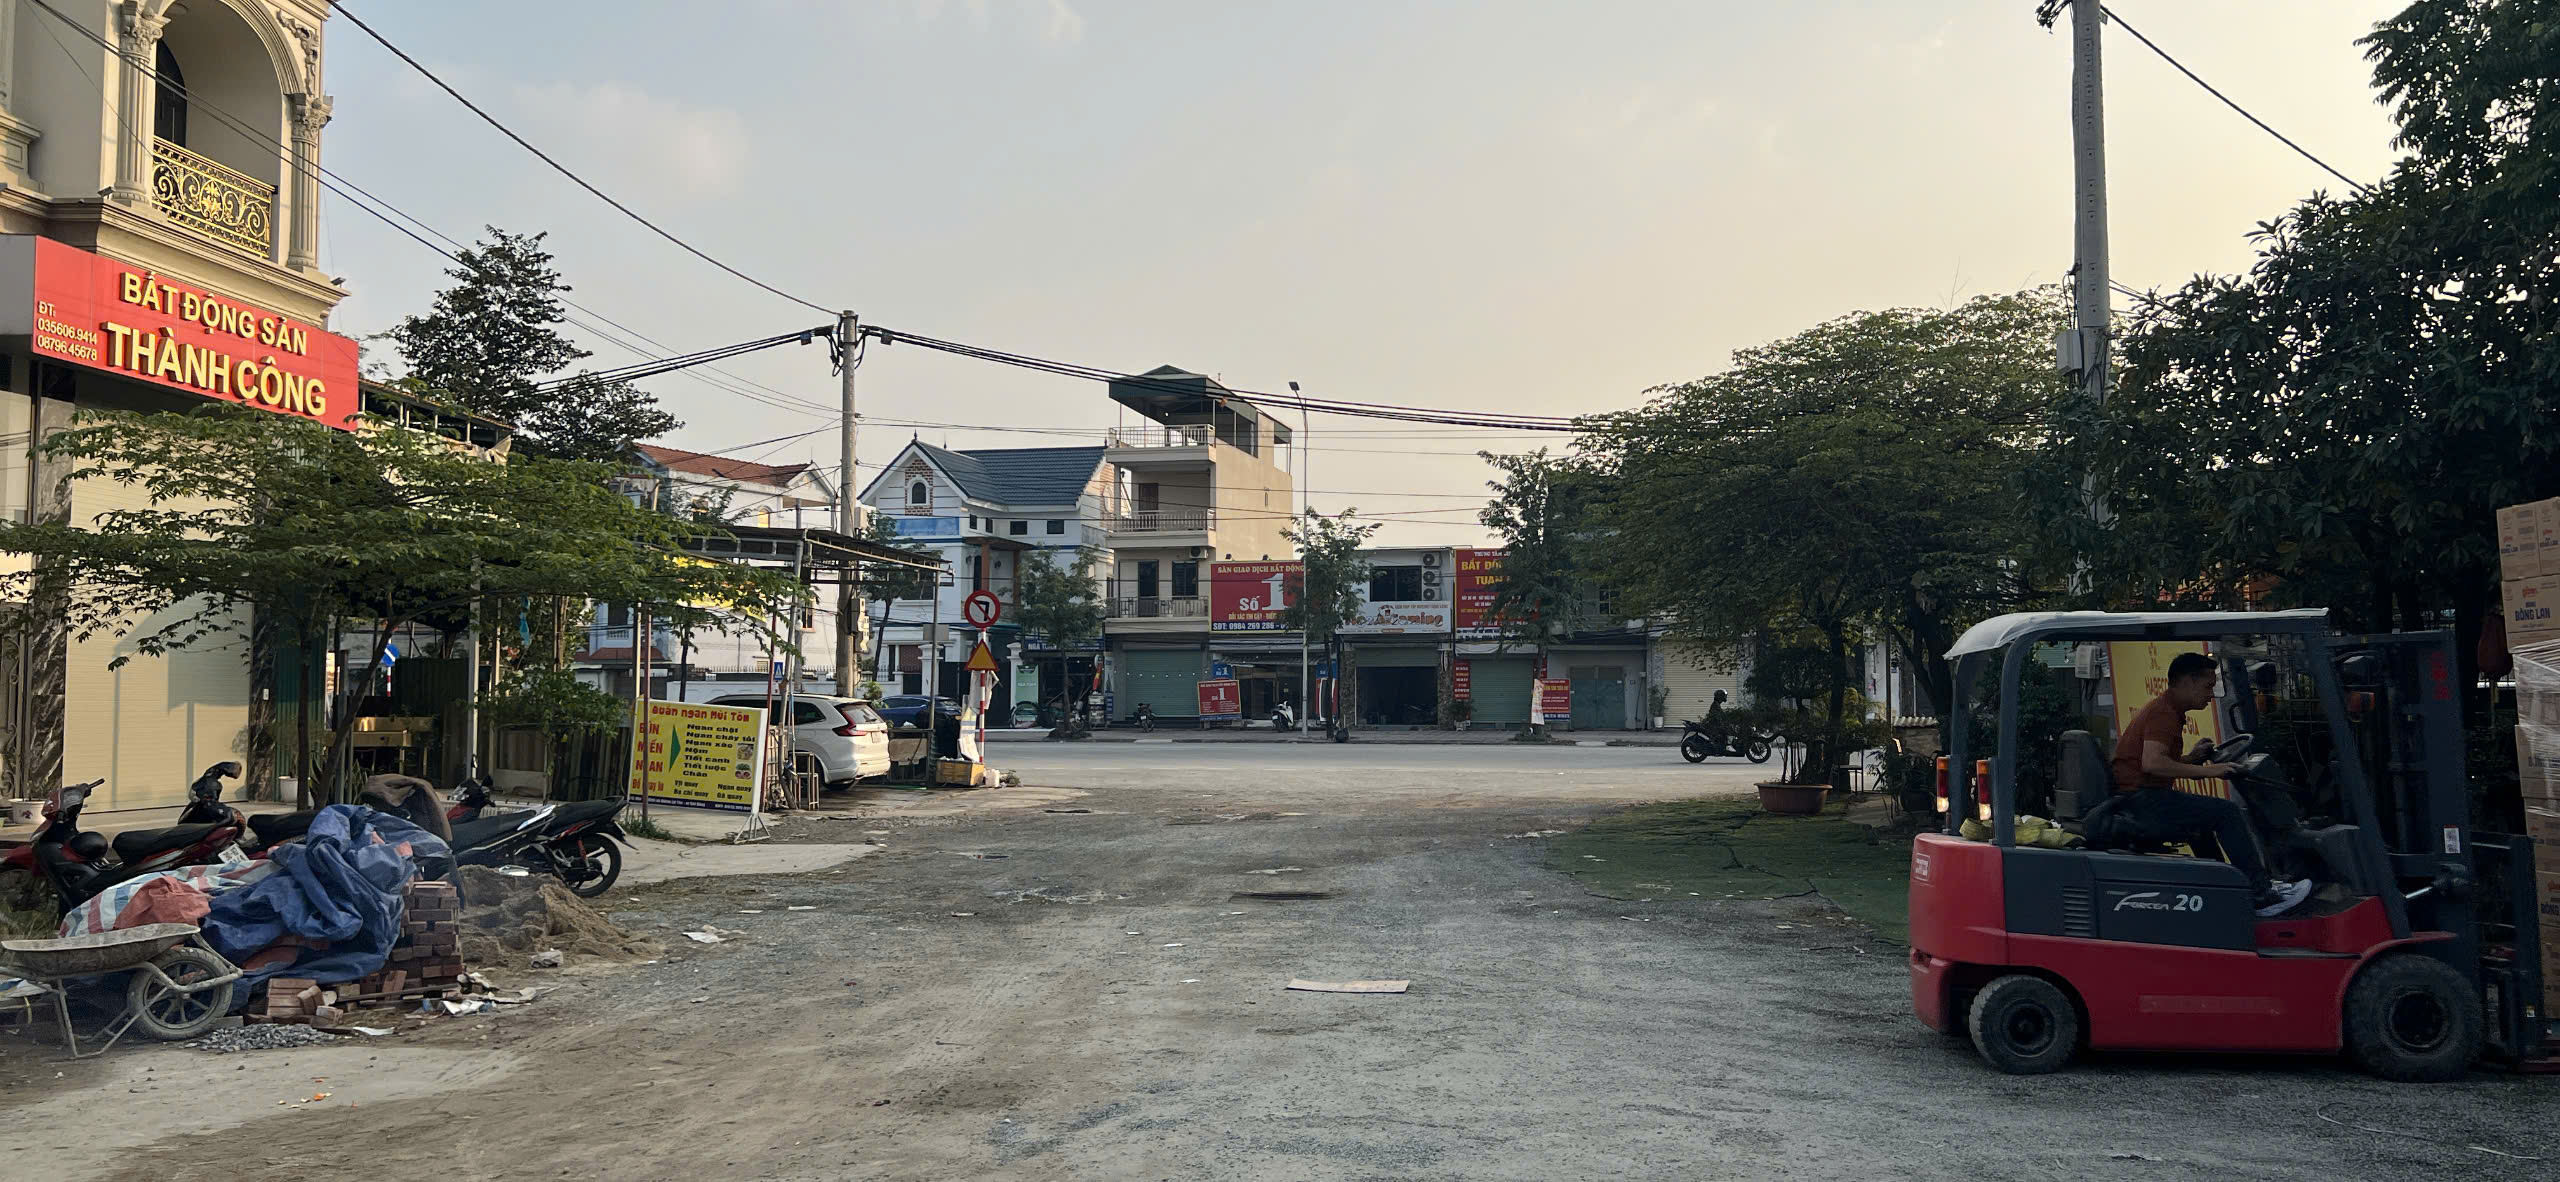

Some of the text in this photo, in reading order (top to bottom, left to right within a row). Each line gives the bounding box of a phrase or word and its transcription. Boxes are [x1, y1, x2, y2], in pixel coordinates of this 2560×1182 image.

[120, 271, 307, 356] BẤT ĐỘNG SẢN
[37, 317, 98, 345] 035606.9414
[37, 335, 98, 361] 08796.45678
[101, 321, 326, 416] THÀNH CÔNG
[1217, 565, 1232, 573] SÀN
[1252, 565, 1269, 574] DỊCH
[1240, 573, 1291, 611] Số 1
[681, 709, 707, 719] ngan
[635, 760, 663, 772] NAN
[2173, 894, 2203, 912] 20
